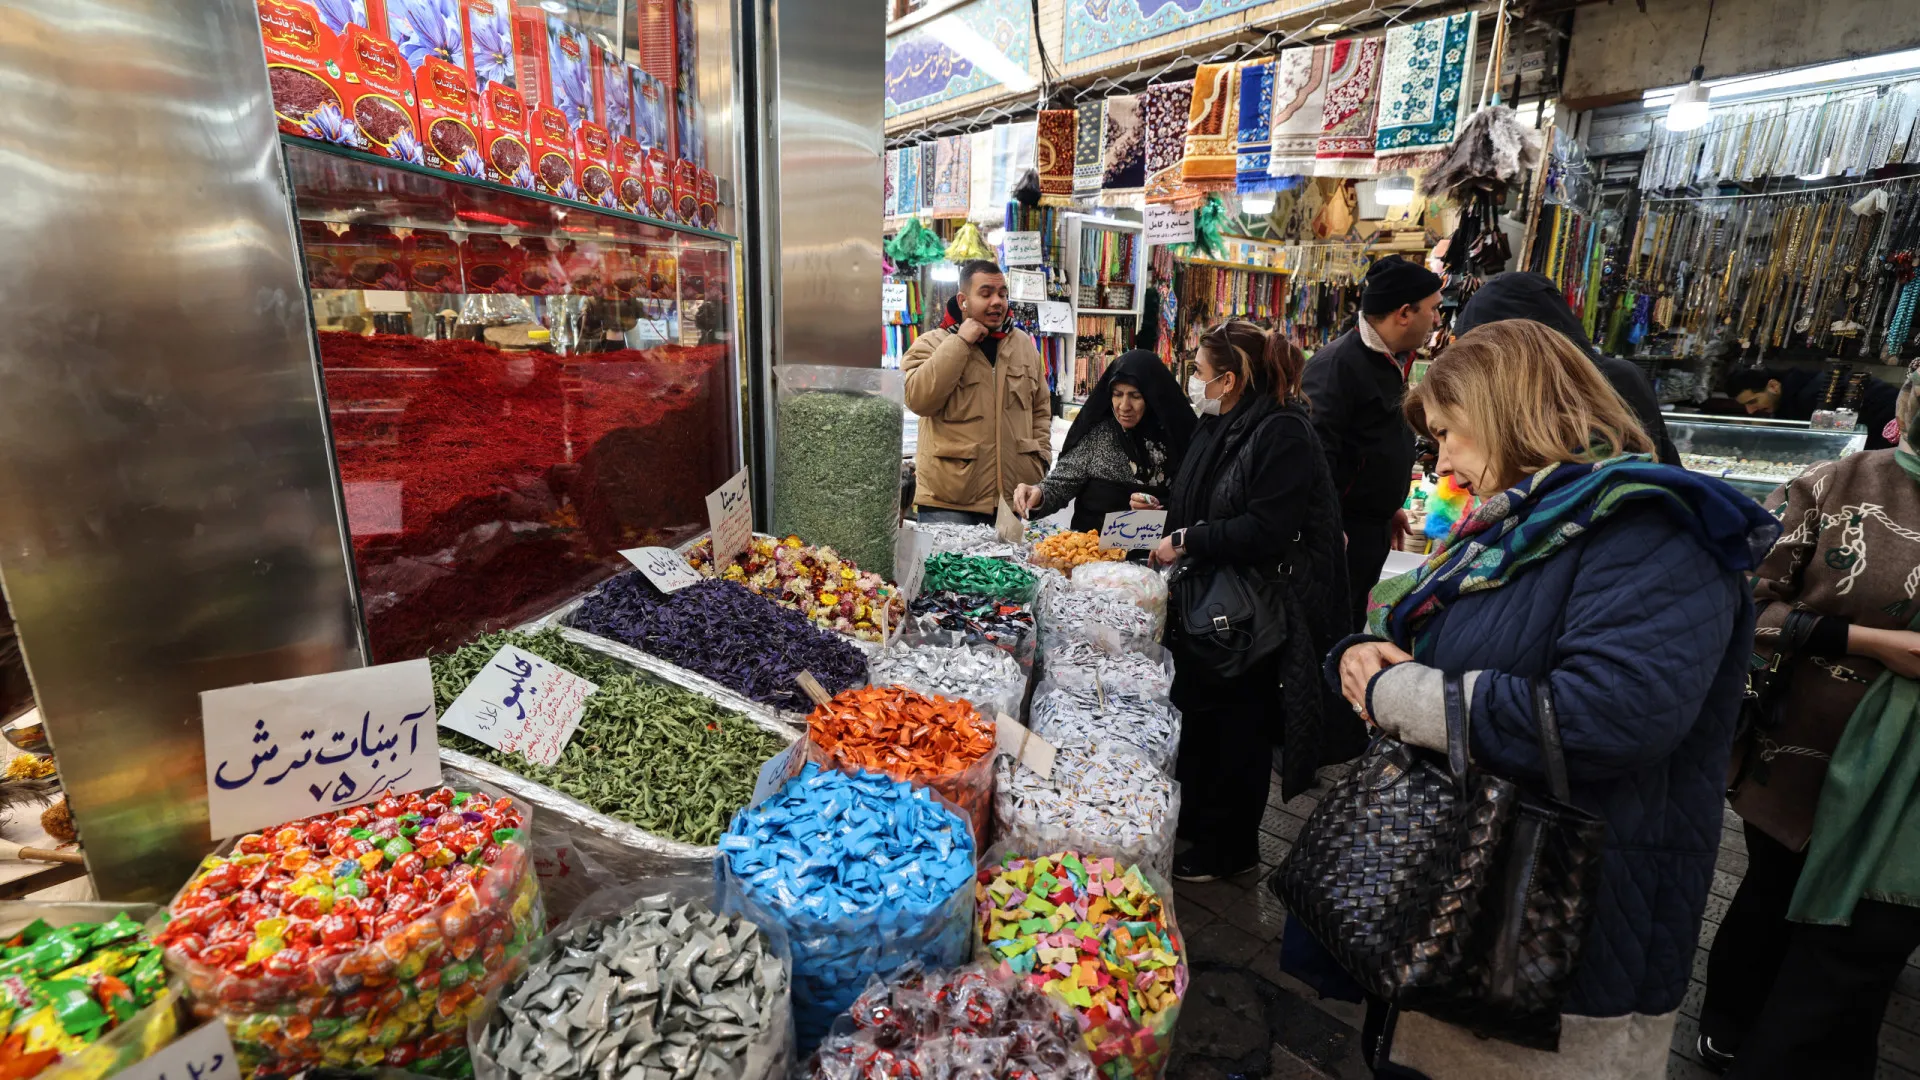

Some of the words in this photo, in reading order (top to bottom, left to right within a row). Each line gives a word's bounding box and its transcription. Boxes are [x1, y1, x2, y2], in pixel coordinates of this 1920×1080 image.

[260, 14, 289, 28] قائنات
[290, 22, 312, 36] ممتاز
[265, 45, 280, 56] The
[280, 49, 295, 60] Best
[296, 55, 319, 68] Quality
[361, 51, 380, 62] قائنات
[381, 57, 396, 69] ممتاز
[384, 86, 400, 97] Quality
[1149, 220, 1163, 231] کامل
[1170, 220, 1190, 228] جامع
[720, 491, 736, 512] مینا
[1103, 510, 1138, 536] میگو
[1119, 523, 1163, 540] چیپس
[314, 704, 431, 769] آبنبات
[214, 719, 315, 790] ترش
[308, 771, 357, 802] ۷۵
